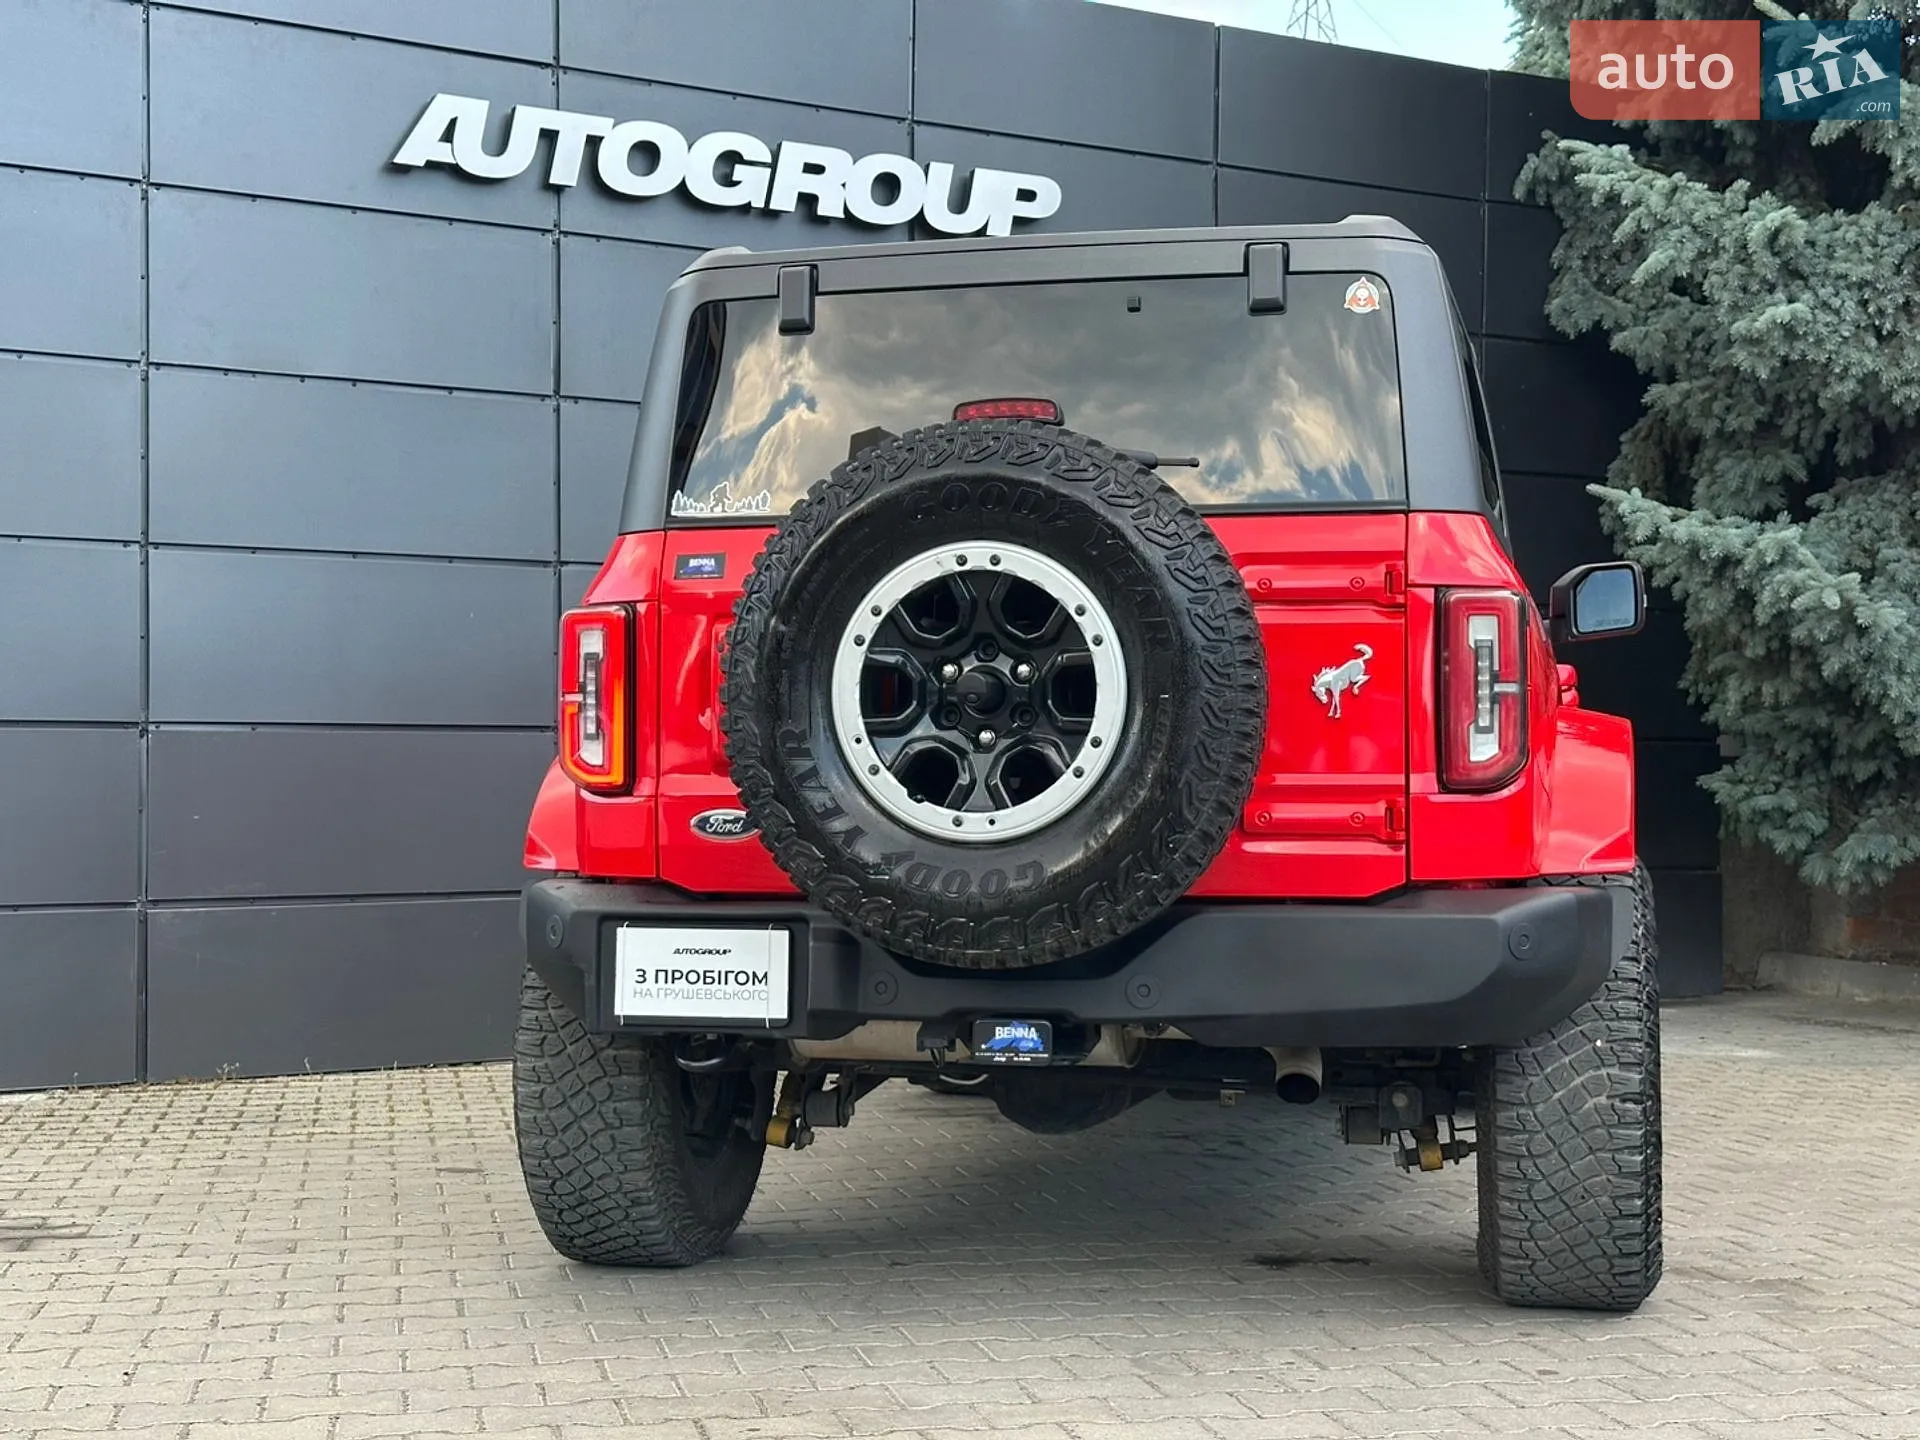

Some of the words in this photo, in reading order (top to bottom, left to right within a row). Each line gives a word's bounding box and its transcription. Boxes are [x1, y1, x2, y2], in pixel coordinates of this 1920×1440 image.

[392, 92, 1062, 237] AUTOGROUP
[705, 815, 744, 832] Ford
[672, 947, 731, 956] AUTOGROUP
[654, 969, 768, 986] ПРОБІГОМ
[633, 988, 653, 999] НА
[656, 988, 769, 1001] ГРУШЕВСЬКОГО
[995, 1026, 1037, 1040] BENNA
